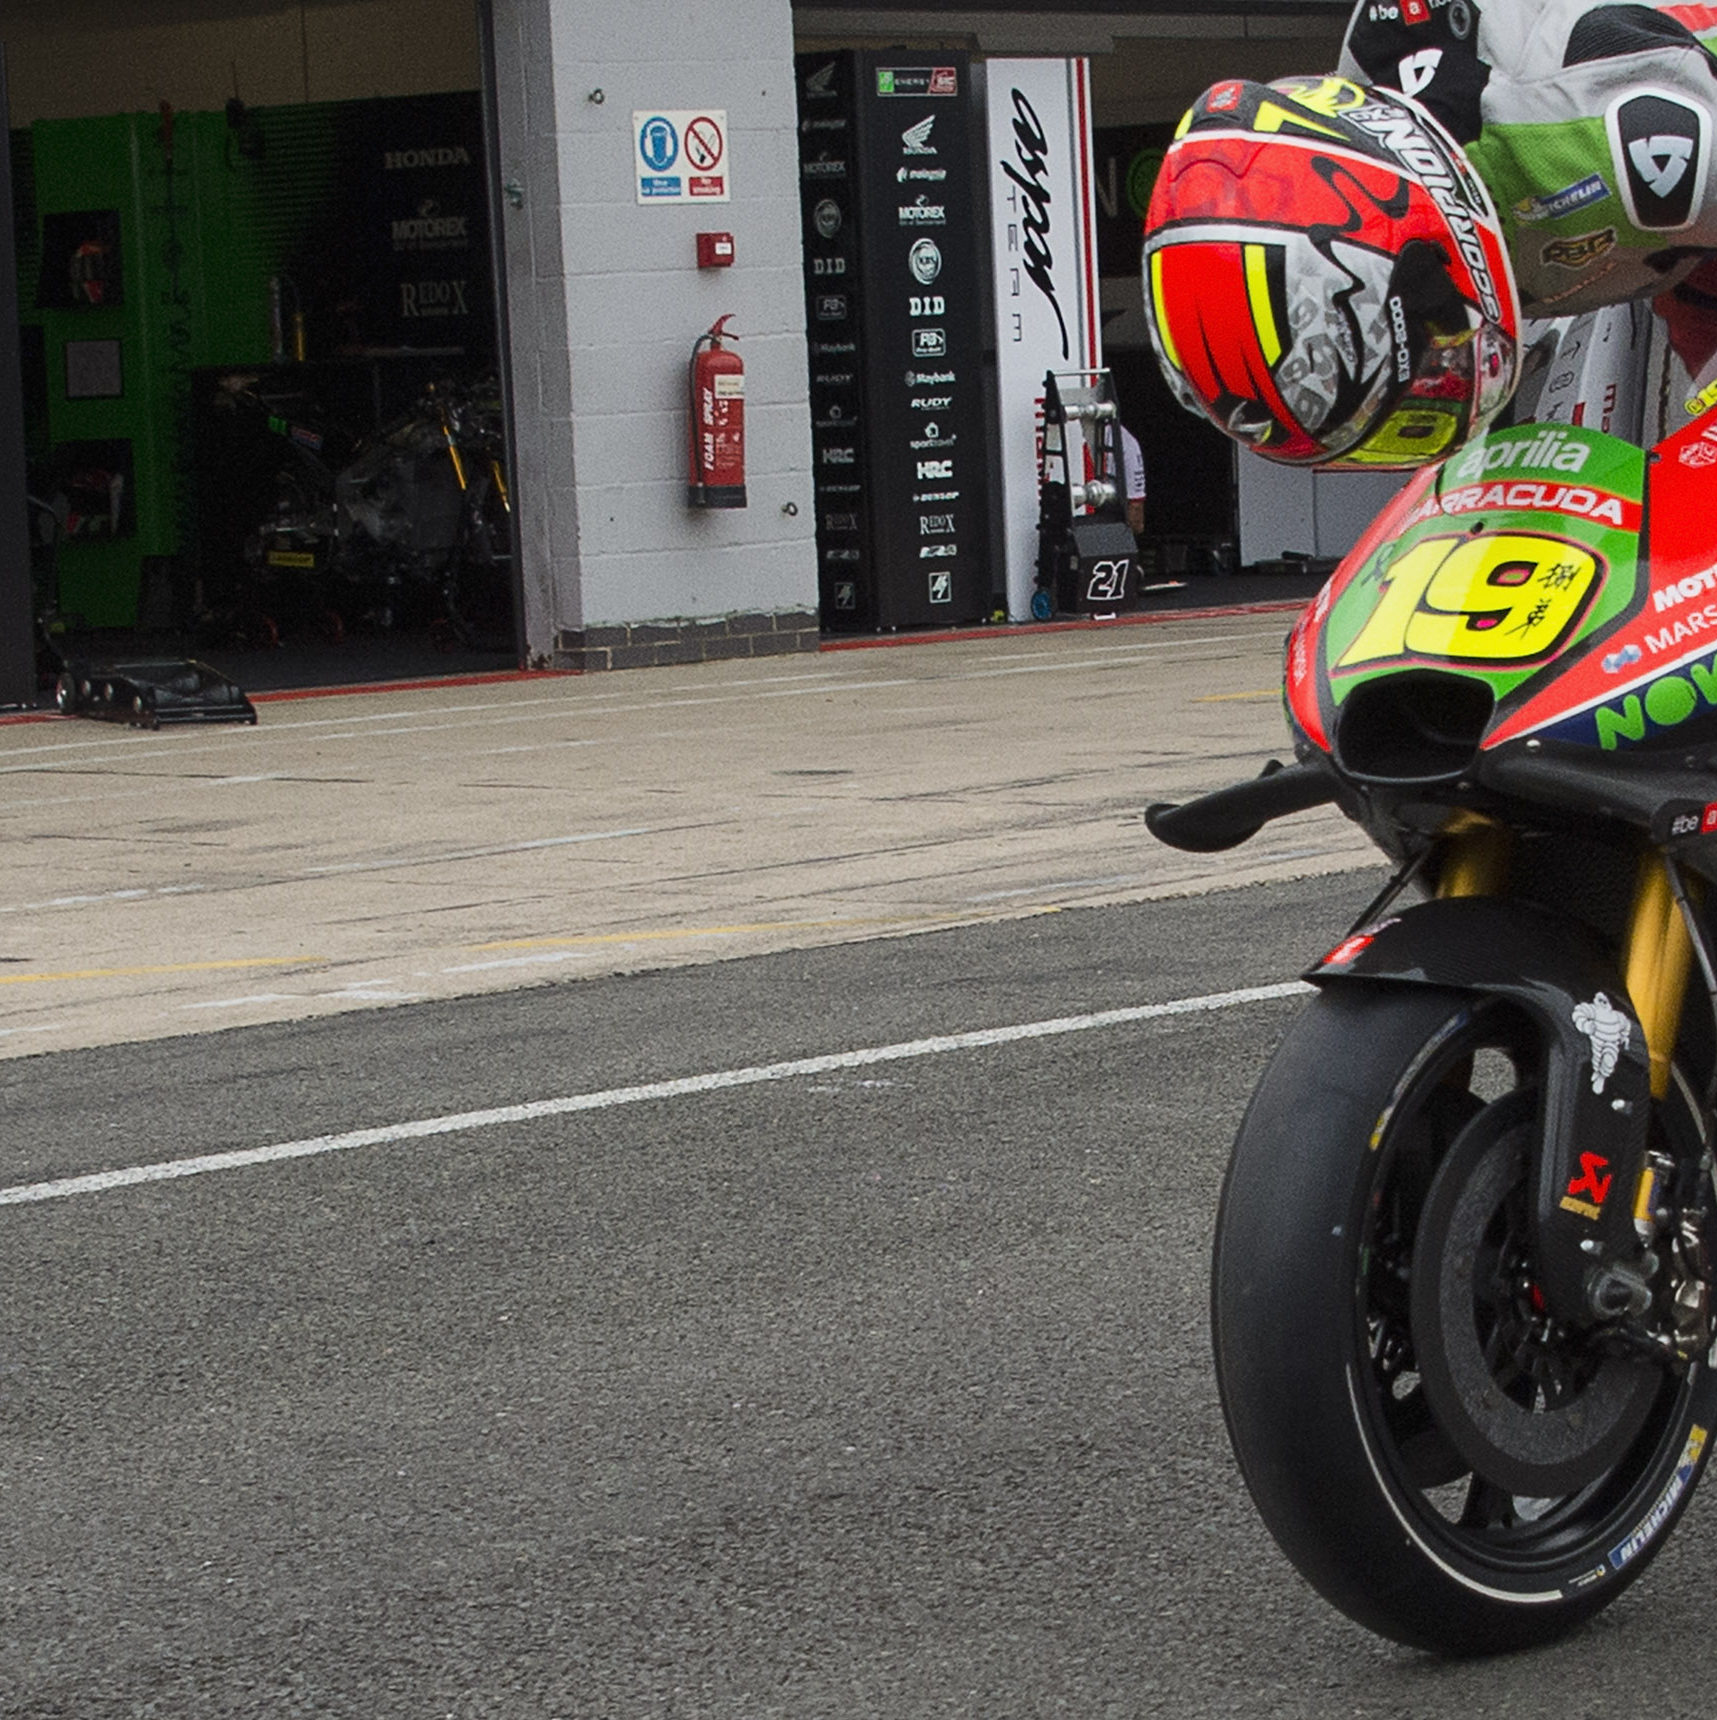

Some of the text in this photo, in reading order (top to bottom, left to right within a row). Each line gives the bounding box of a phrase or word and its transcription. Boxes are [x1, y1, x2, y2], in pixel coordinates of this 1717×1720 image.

[384, 148, 469, 169] HONDA
[391, 216, 467, 240] MOTOREX
[899, 206, 946, 220] MOTOREX
[916, 459, 954, 480] HRC
[1456, 431, 1593, 479] aprilia
[1086, 559, 1130, 601] 21
[1337, 534, 1597, 668] 19
[1619, 1474, 1684, 1562] MICHELIN
